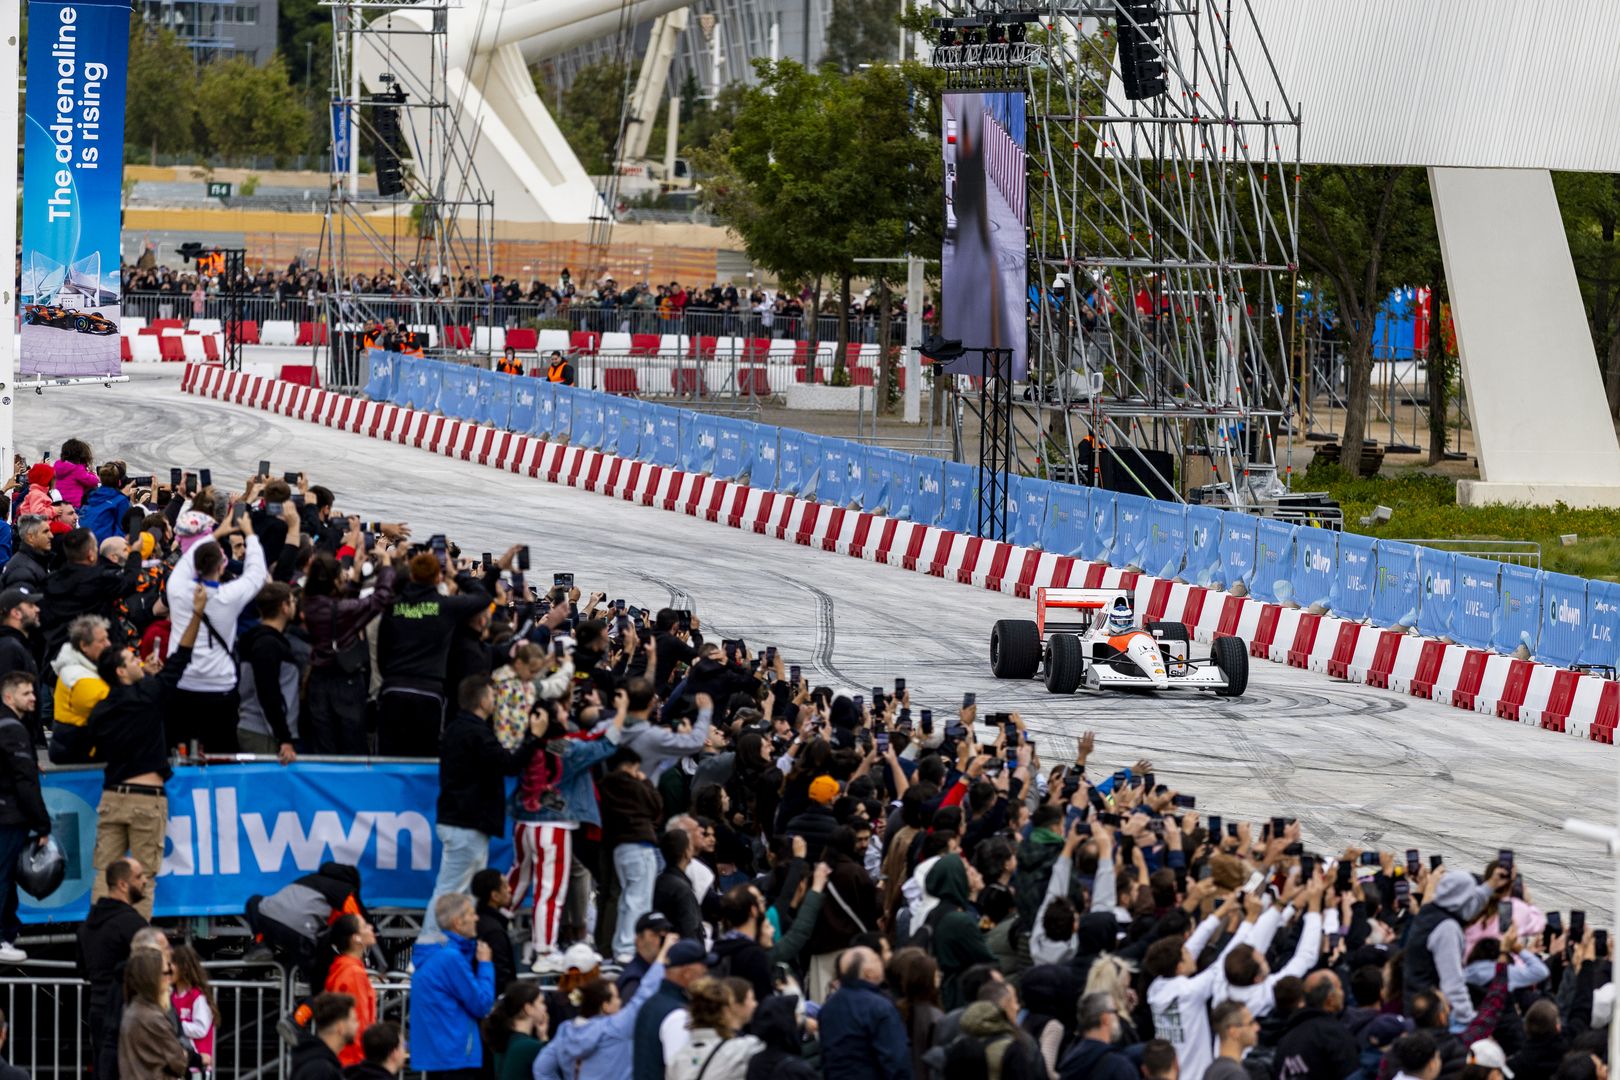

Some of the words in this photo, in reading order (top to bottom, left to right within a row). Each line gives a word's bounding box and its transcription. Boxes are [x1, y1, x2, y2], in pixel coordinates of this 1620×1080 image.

[50, 7, 77, 164] adrenaline
[76, 62, 108, 140] rising
[76, 147, 98, 169] is
[48, 169, 72, 223] The
[1312, 548, 1331, 578] allwyn
[1465, 599, 1480, 617] LIVE
[1559, 599, 1580, 631] allwyn
